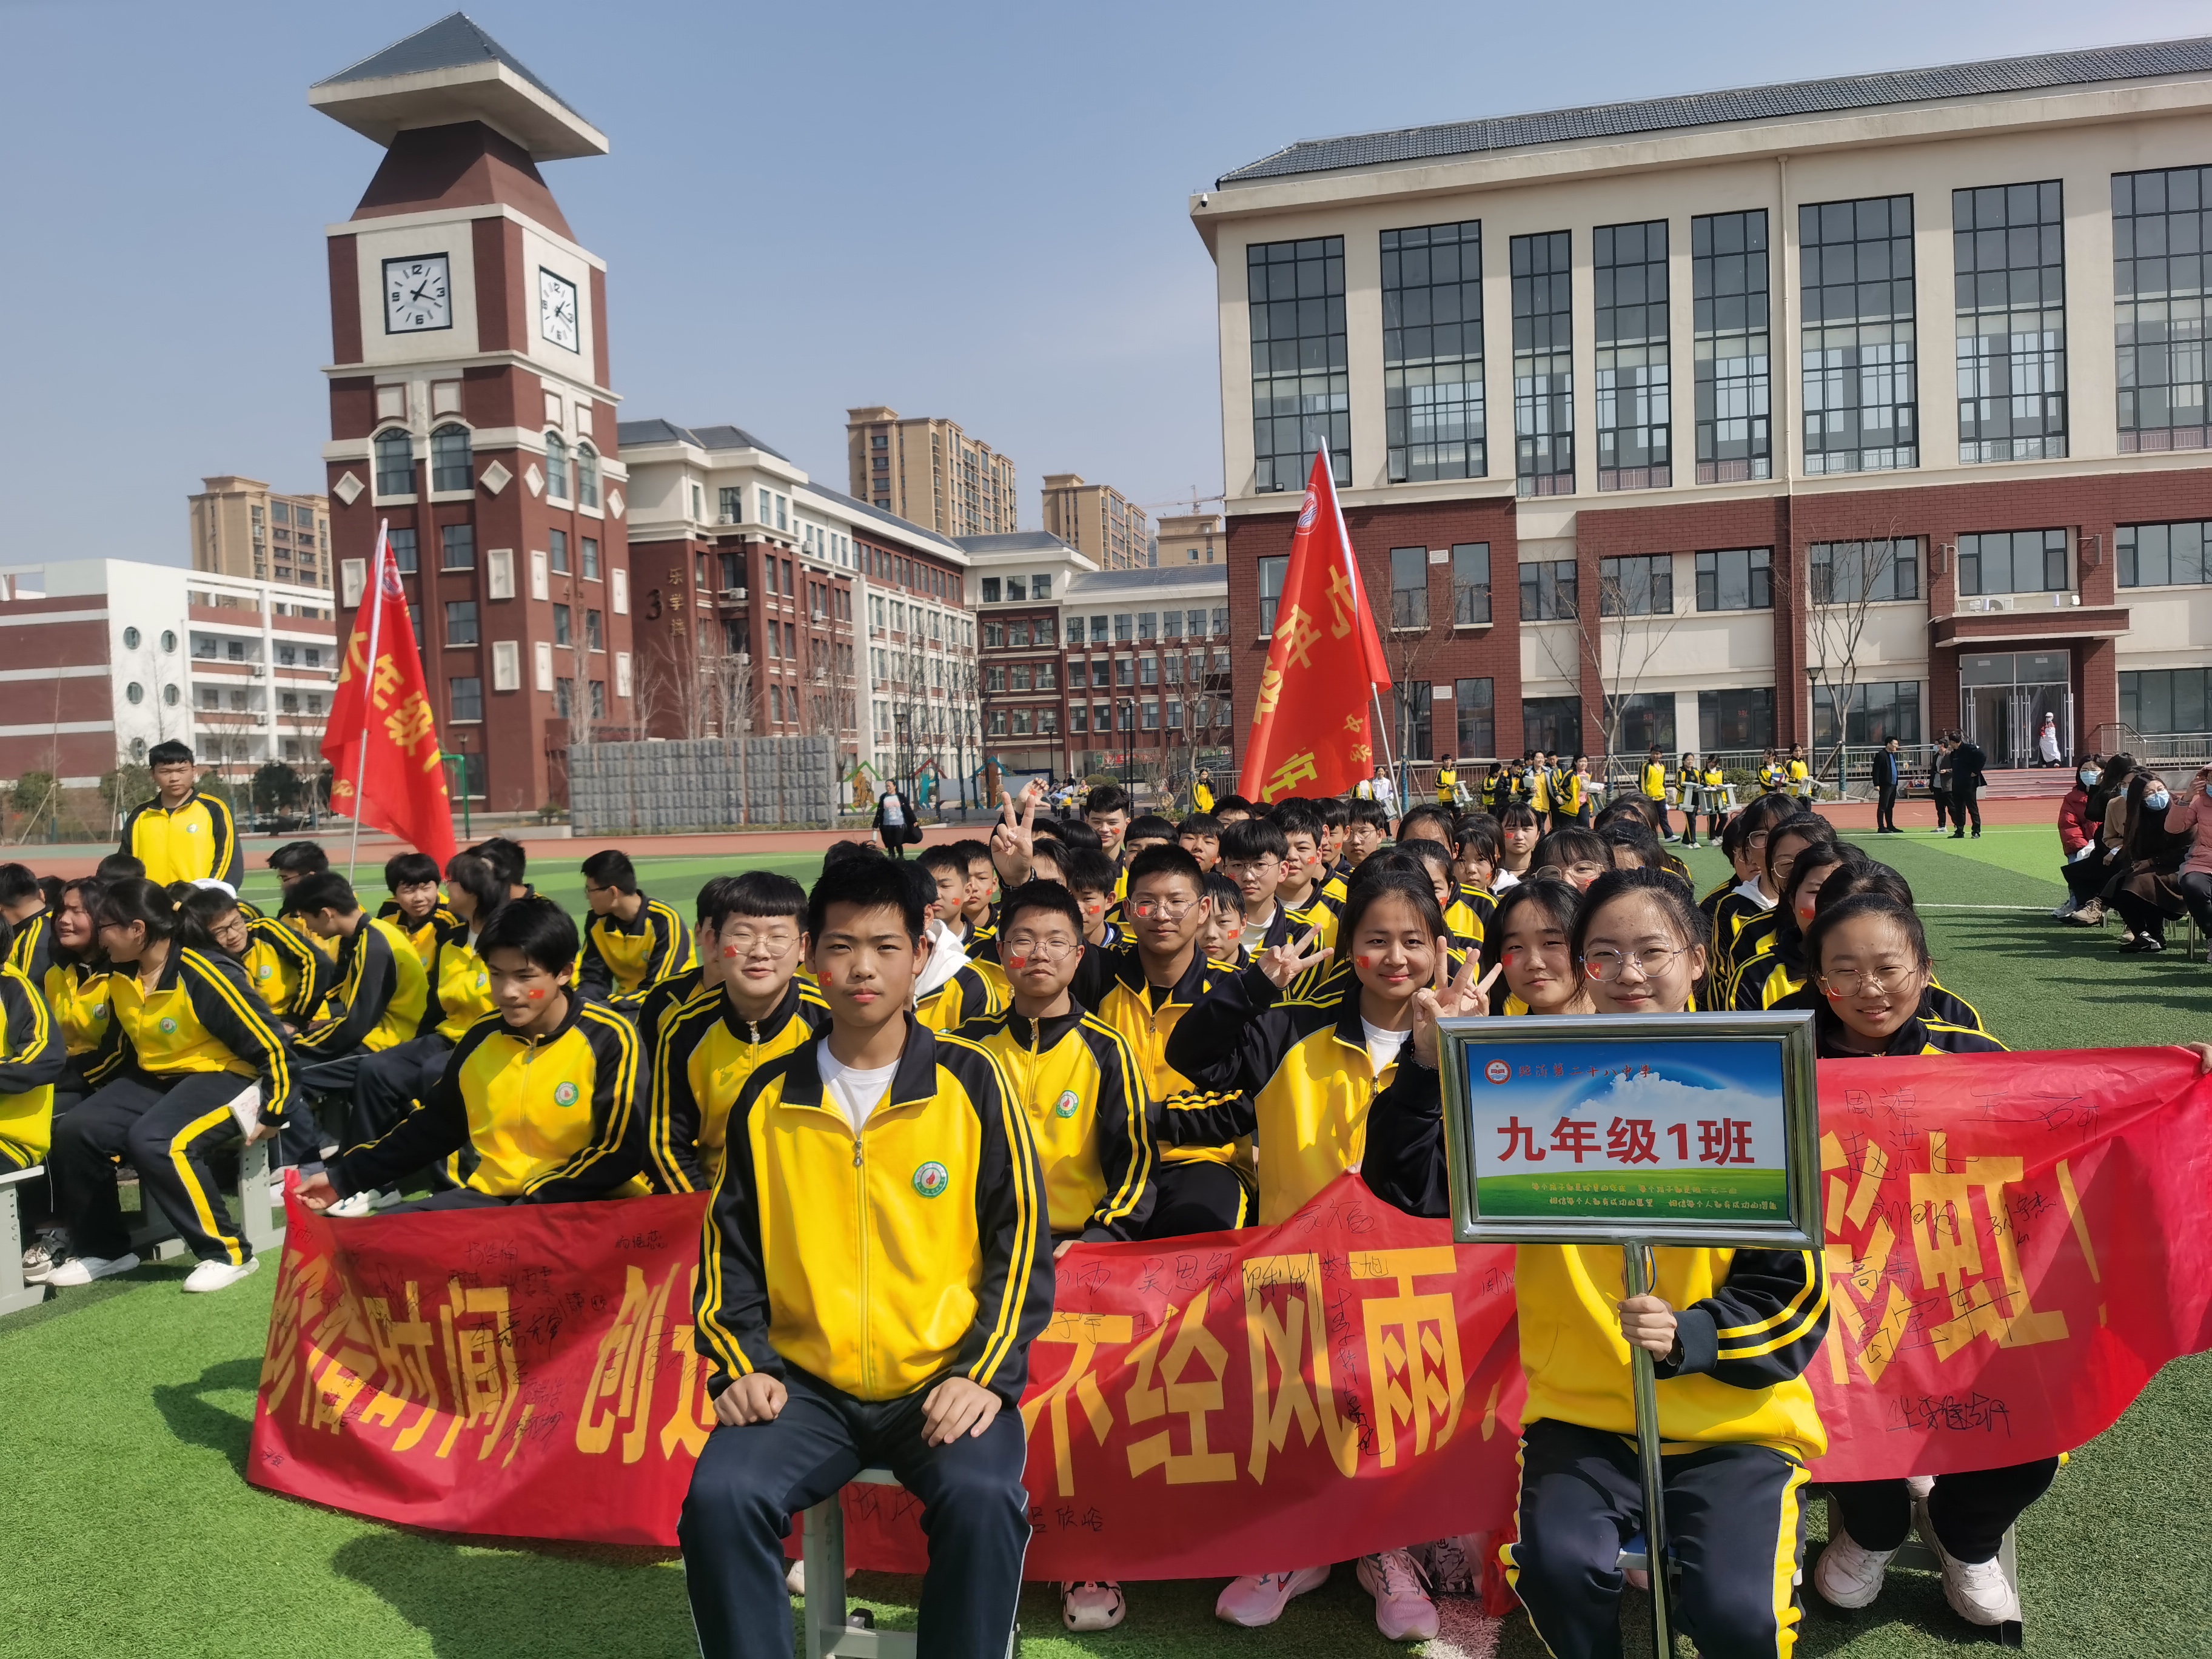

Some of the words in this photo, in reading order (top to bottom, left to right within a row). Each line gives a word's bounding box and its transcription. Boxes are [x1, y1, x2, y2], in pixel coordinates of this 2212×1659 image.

[412, 264, 423, 275] 12
[392, 292, 400, 302] 9
[437, 287, 445, 297] 3
[415, 314, 424, 324] 6
[645, 588, 663, 622] 3
[1496, 1116, 1755, 1166] 九年级1班
